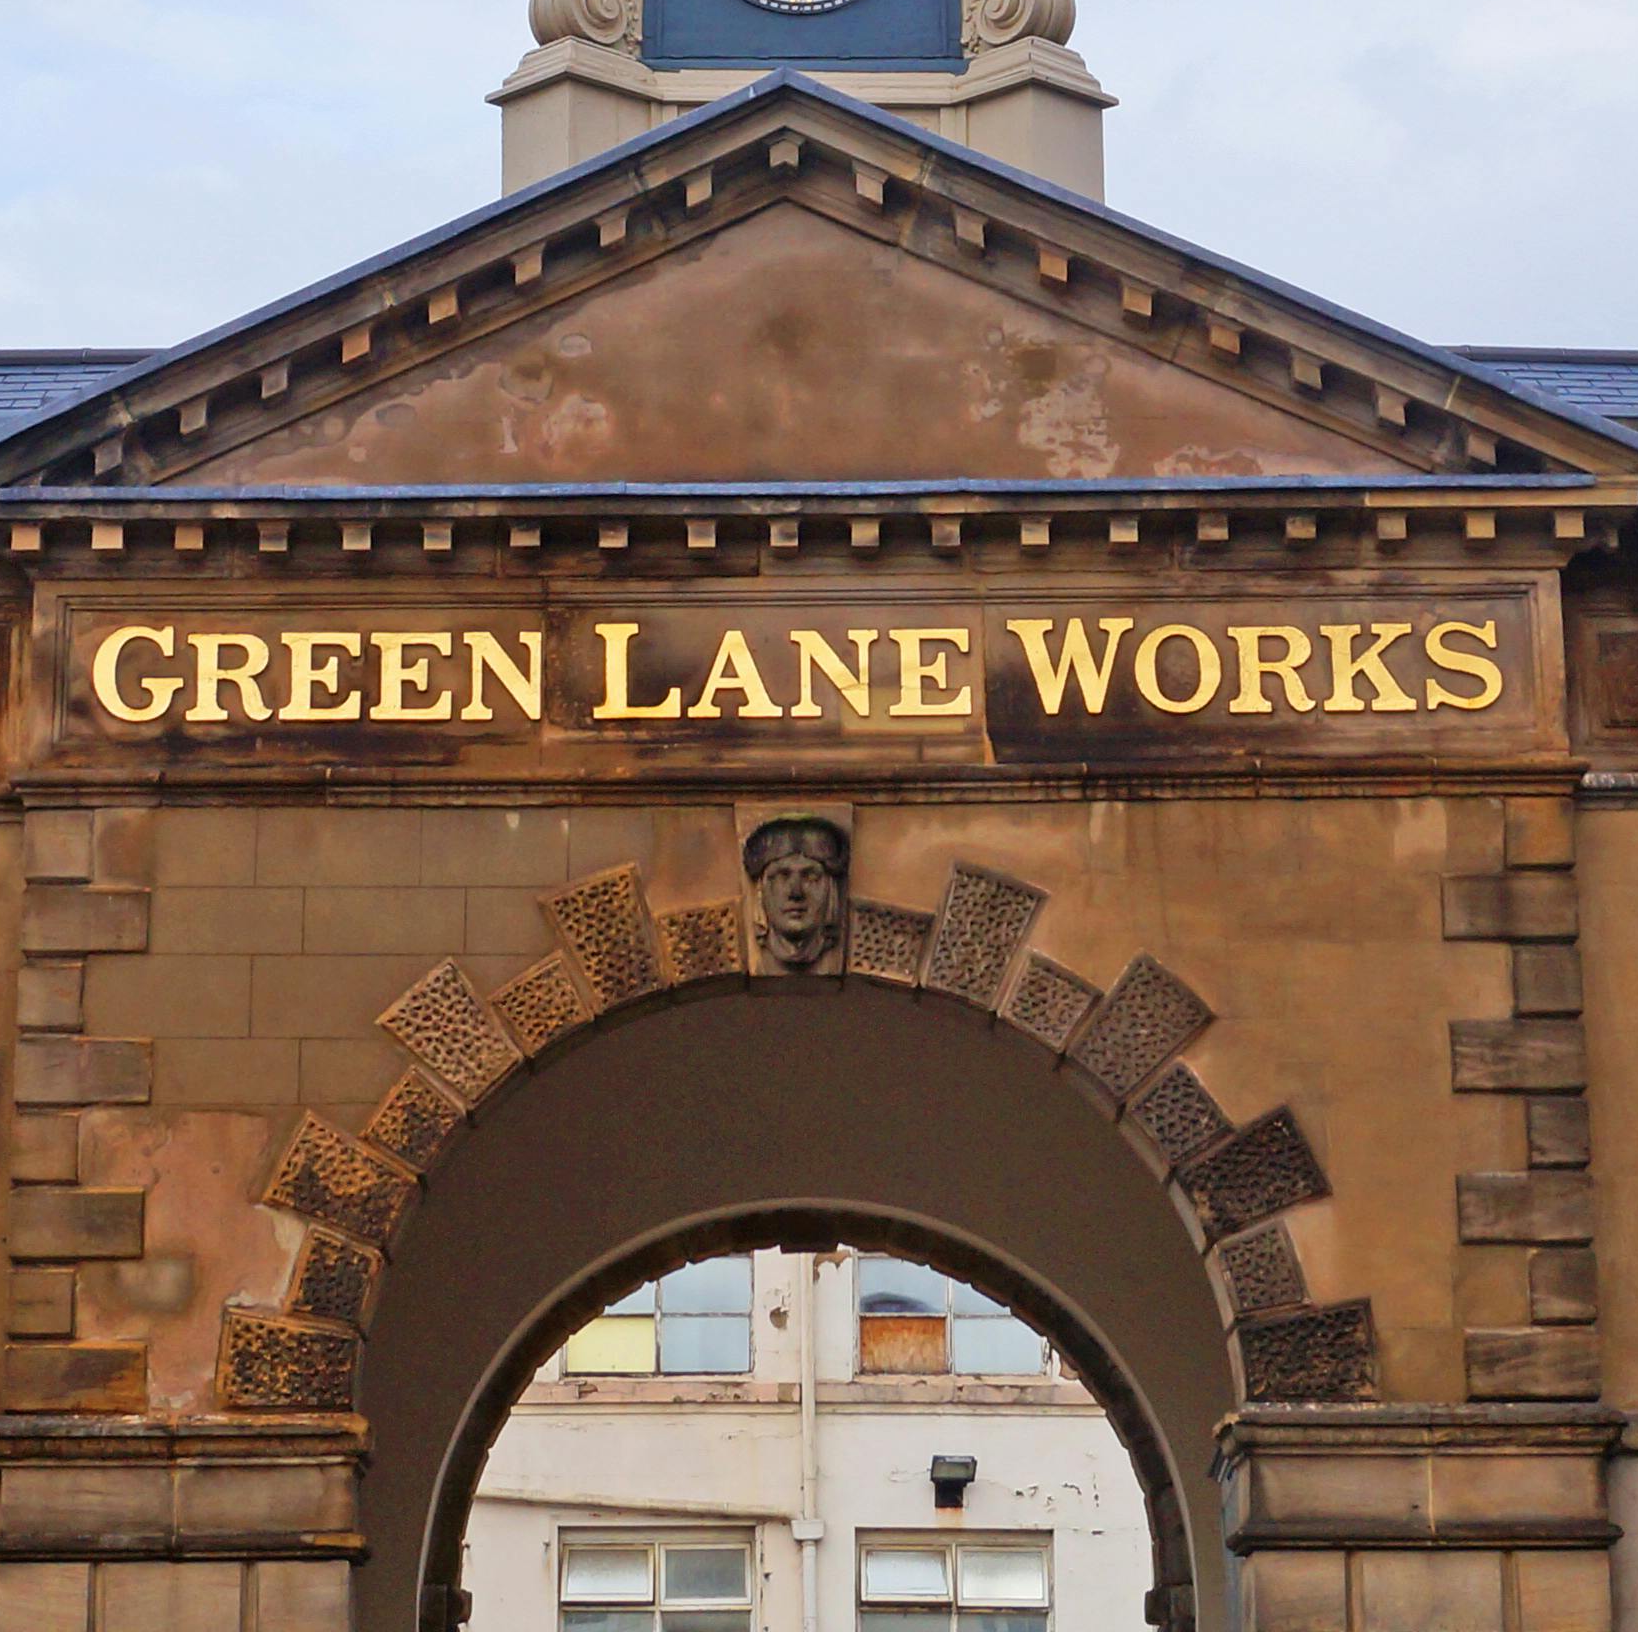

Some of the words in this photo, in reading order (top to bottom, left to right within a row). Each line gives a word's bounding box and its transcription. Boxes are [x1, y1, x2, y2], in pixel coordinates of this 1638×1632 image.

[92, 624, 542, 722] GREEN
[592, 622, 972, 719] LANE
[1005, 617, 1503, 715] WORKS
